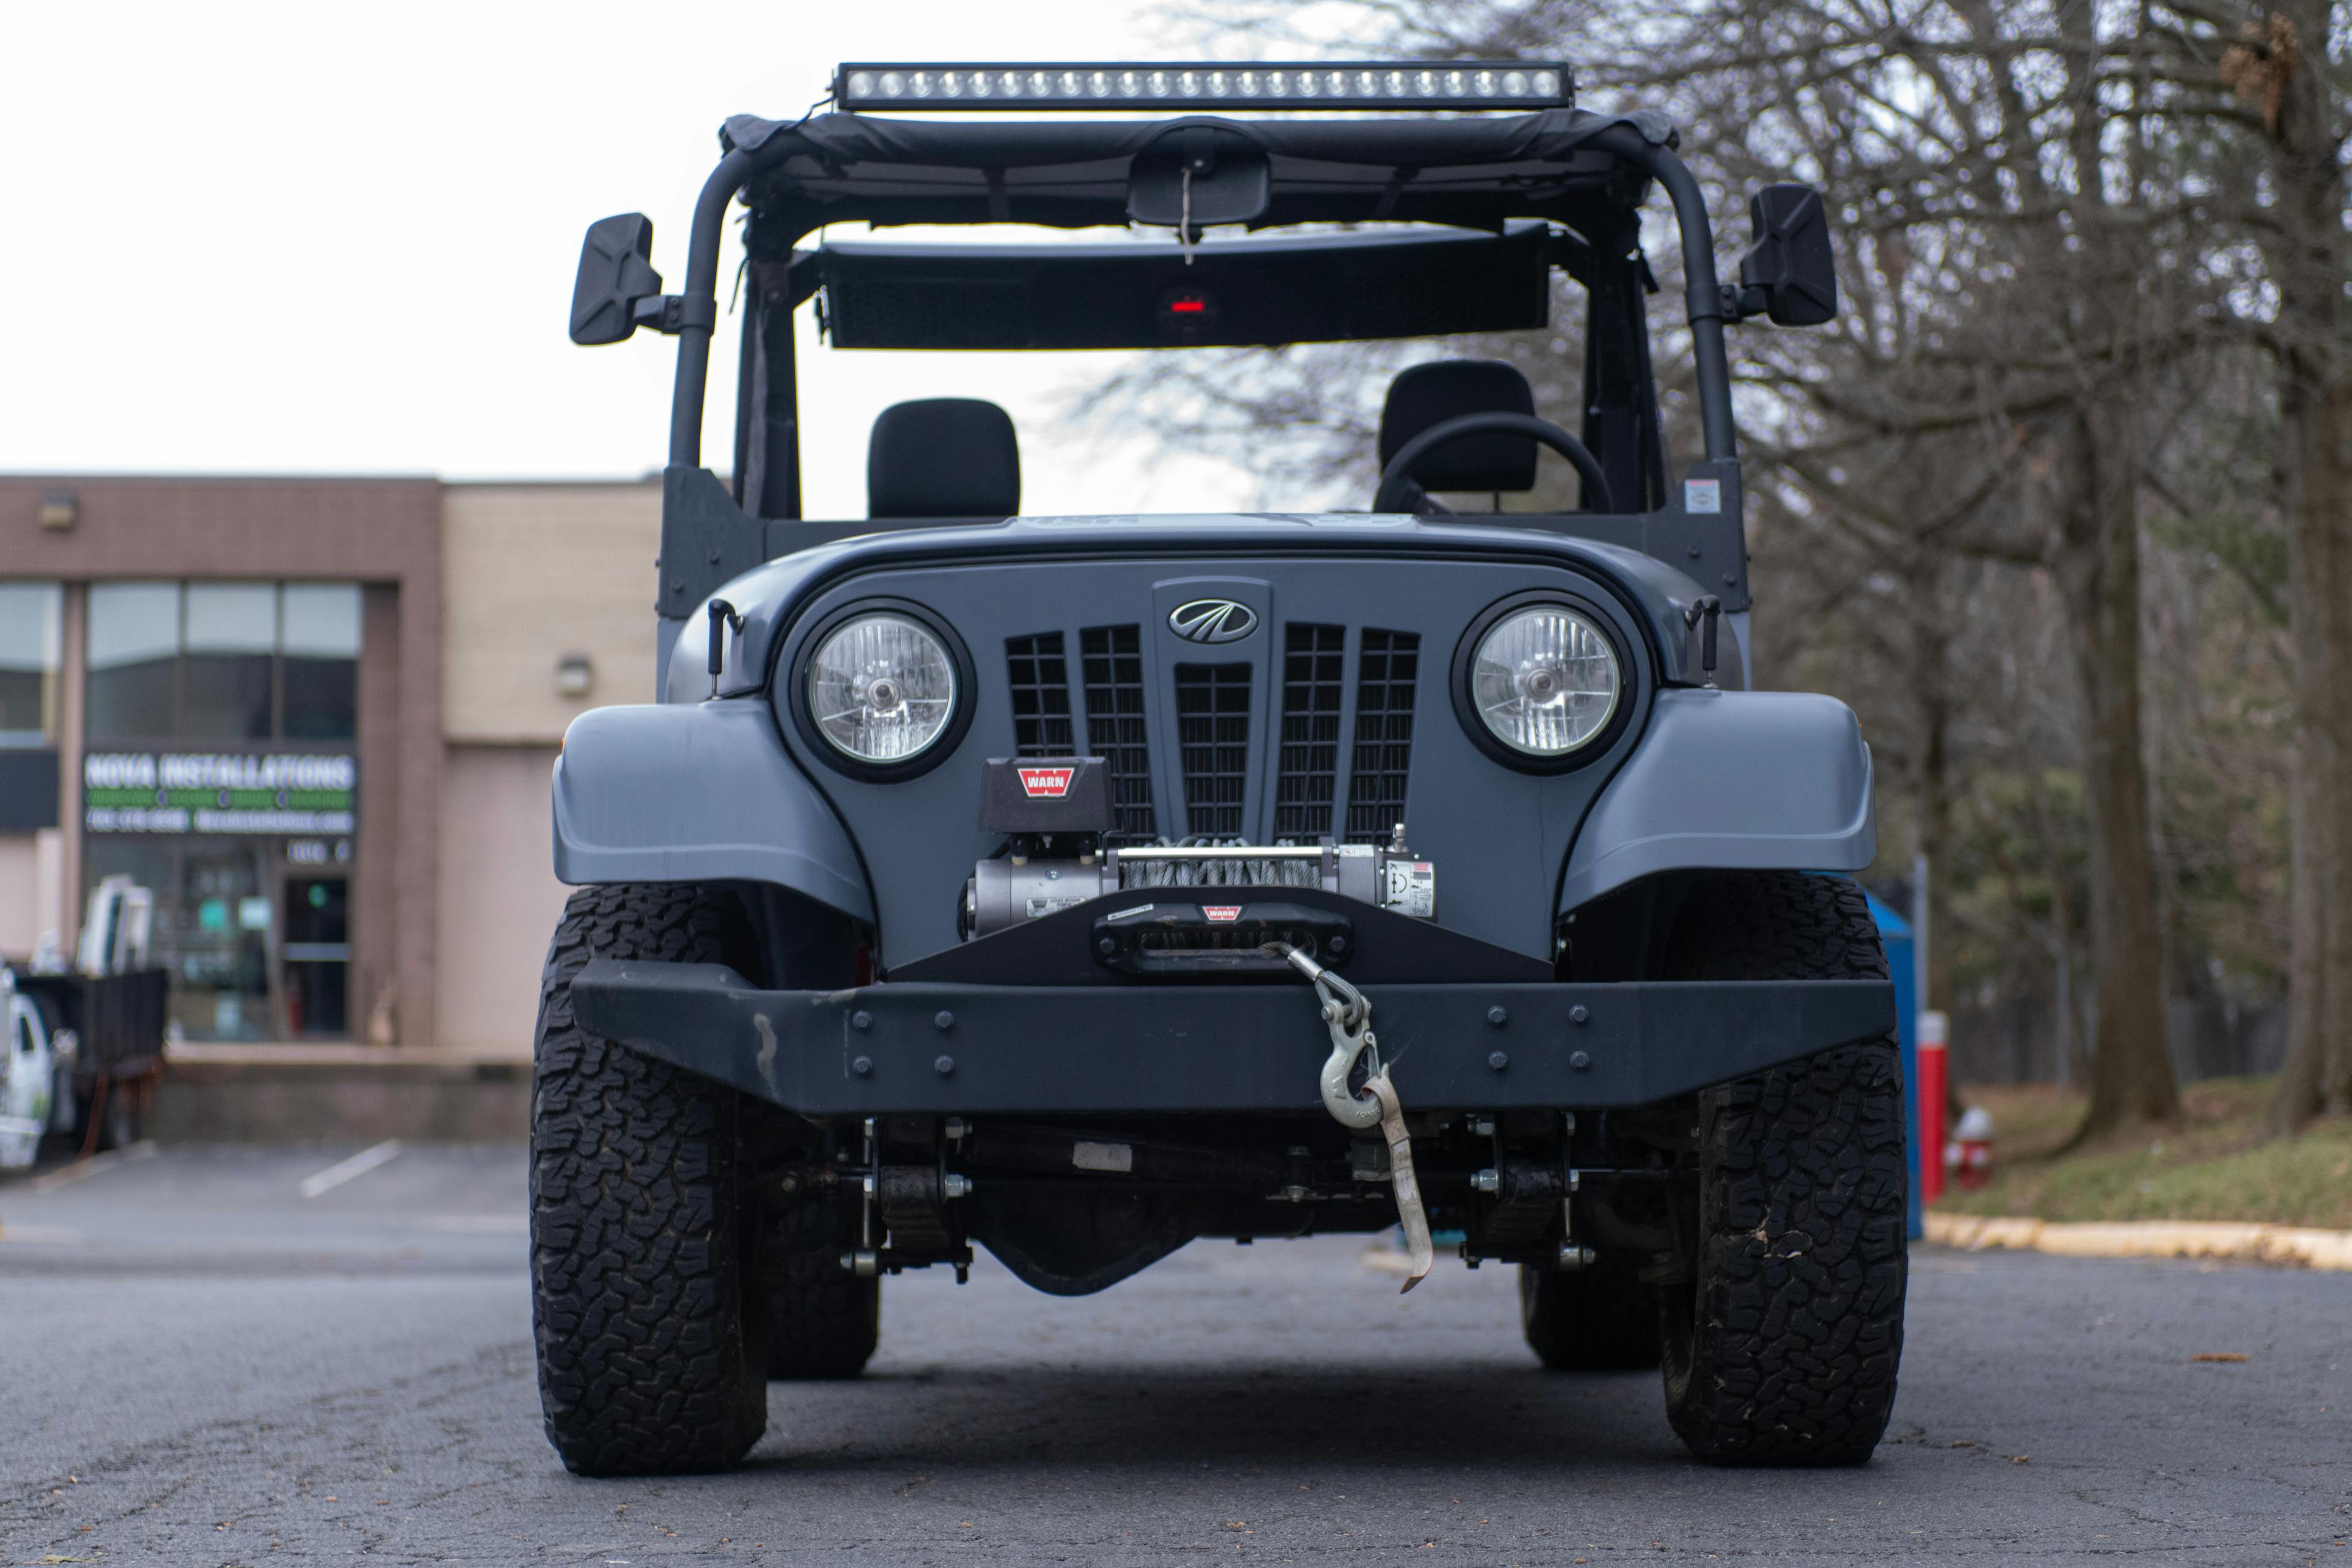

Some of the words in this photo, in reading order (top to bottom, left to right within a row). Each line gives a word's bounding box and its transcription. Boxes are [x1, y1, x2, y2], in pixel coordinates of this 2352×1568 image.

[85, 753, 157, 788] NOVA
[159, 753, 355, 790] INSTALLATIONS
[1027, 776, 1065, 788] WARN
